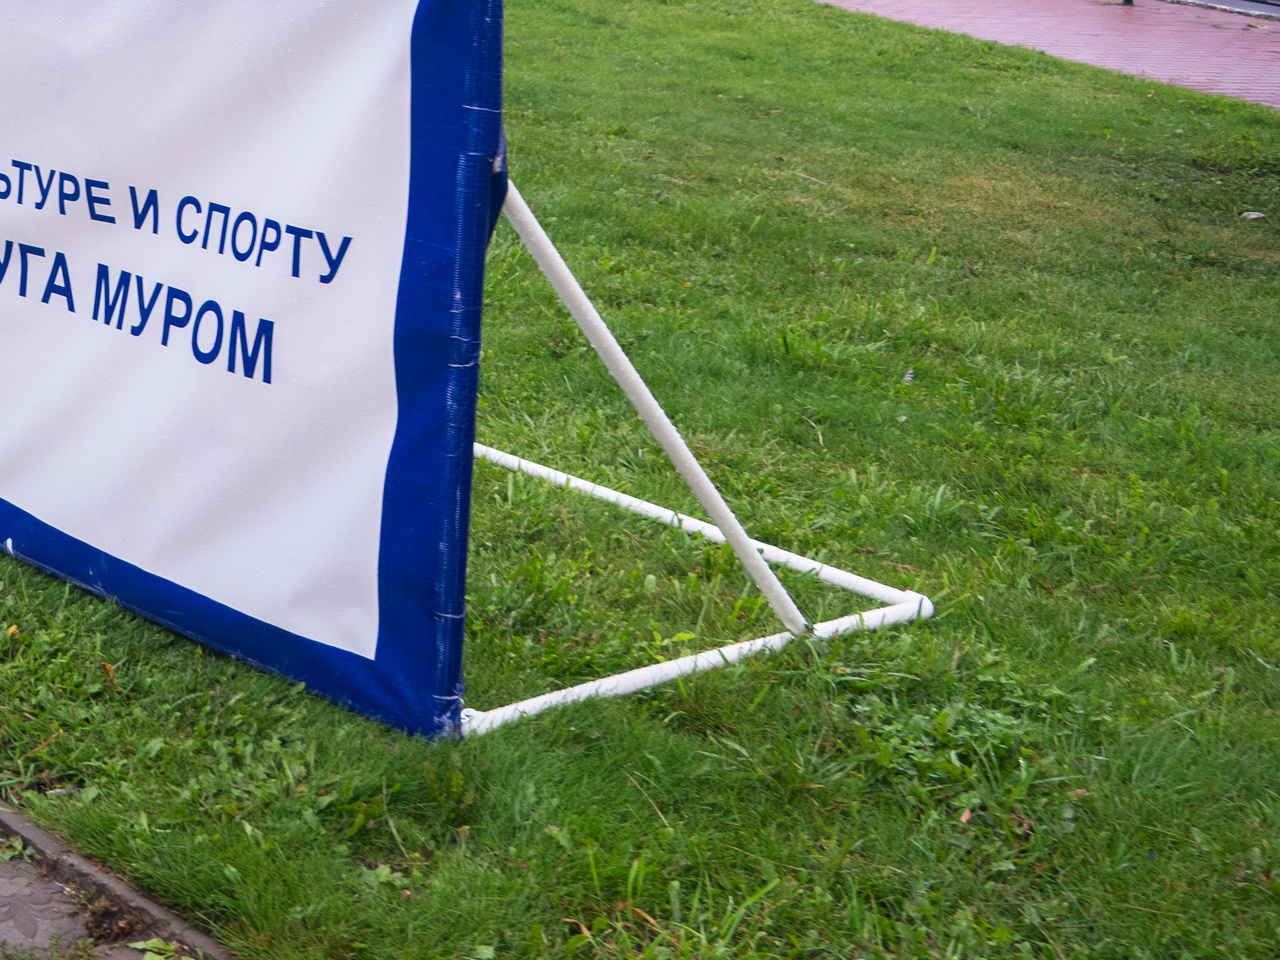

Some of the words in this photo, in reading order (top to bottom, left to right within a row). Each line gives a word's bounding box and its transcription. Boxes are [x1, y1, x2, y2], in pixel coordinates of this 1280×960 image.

[129, 185, 160, 235] И
[176, 195, 354, 284] СПОРТУ
[92, 263, 276, 384] МУРОМ
